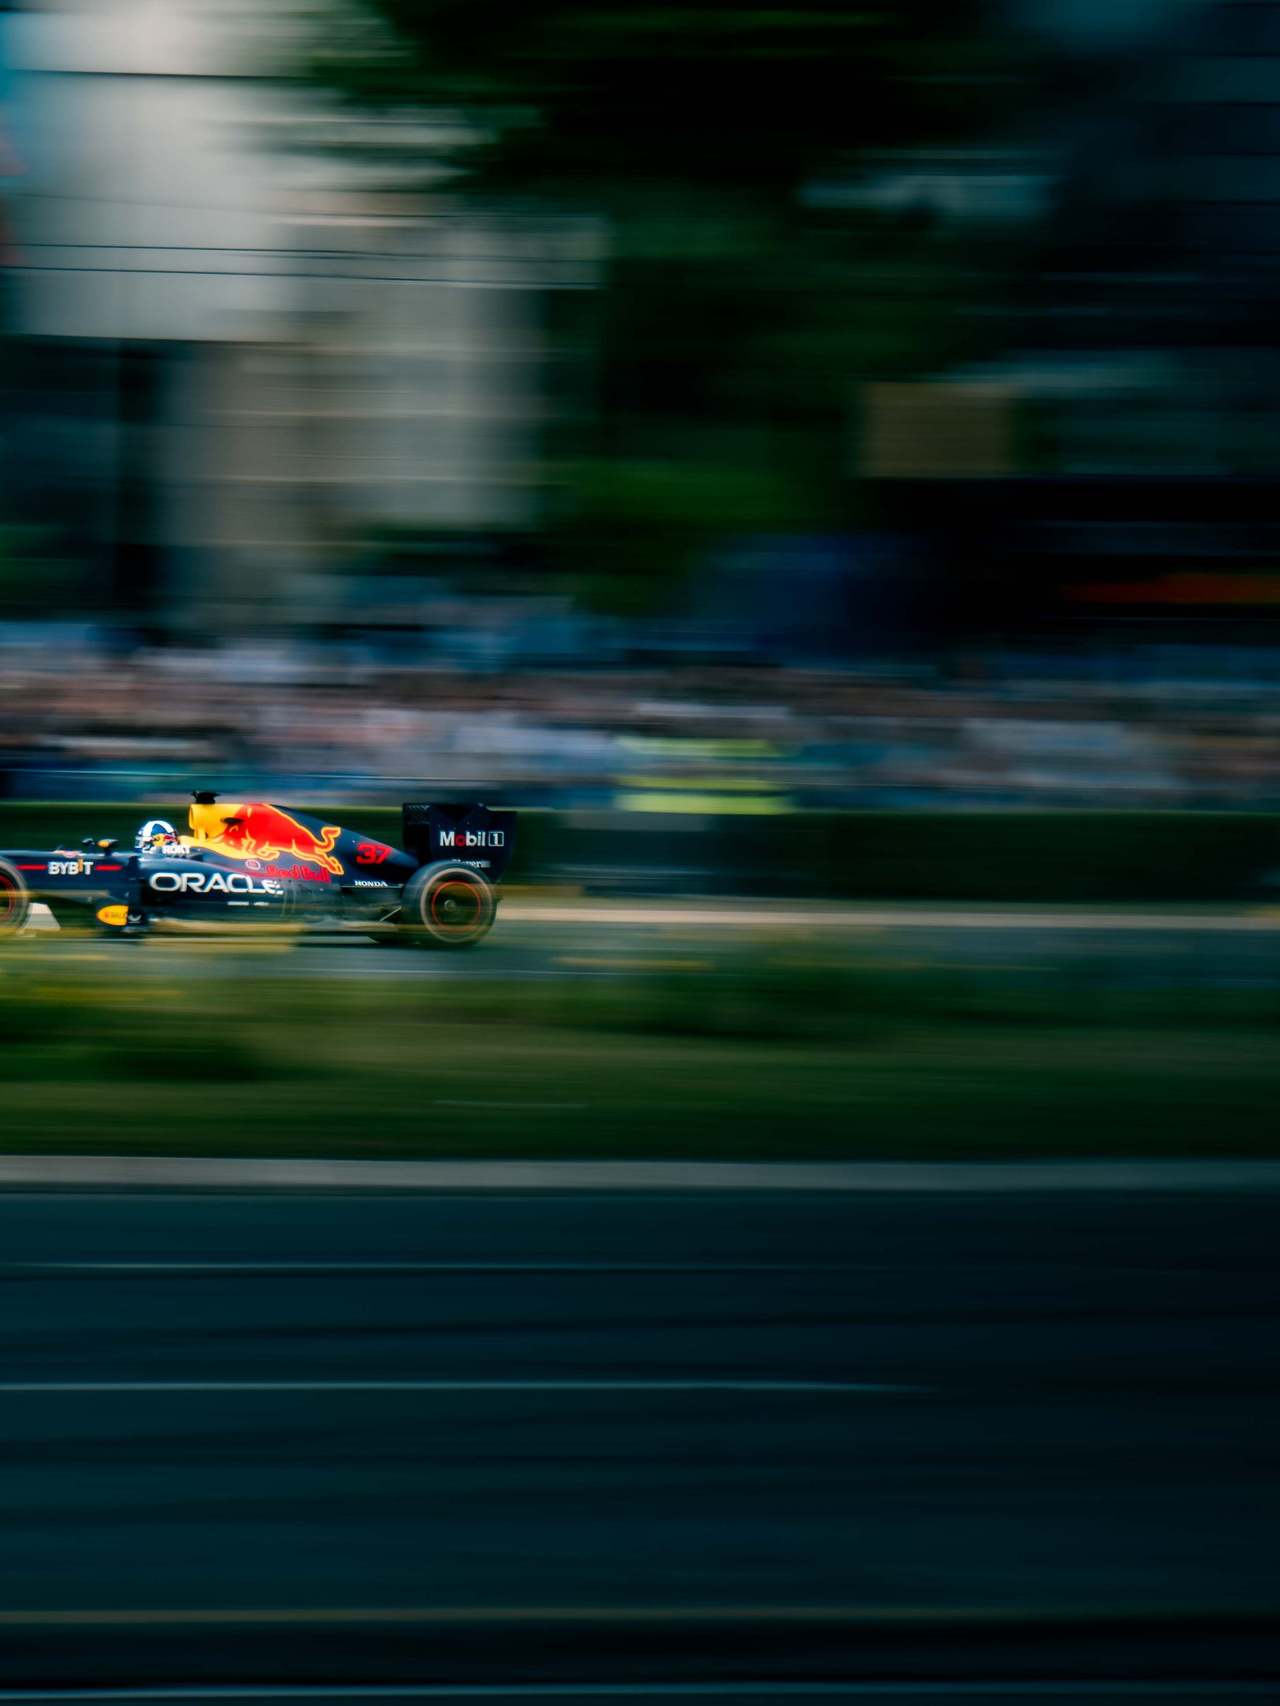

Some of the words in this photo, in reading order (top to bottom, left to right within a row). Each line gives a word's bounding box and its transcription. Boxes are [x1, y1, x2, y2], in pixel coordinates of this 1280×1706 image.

[439, 831, 486, 847] Mobil
[356, 843, 392, 864] 37
[48, 859, 94, 875] BYBIT
[265, 865, 300, 879] Red
[300, 865, 331, 883] Bull
[149, 872, 285, 895] ORACLE
